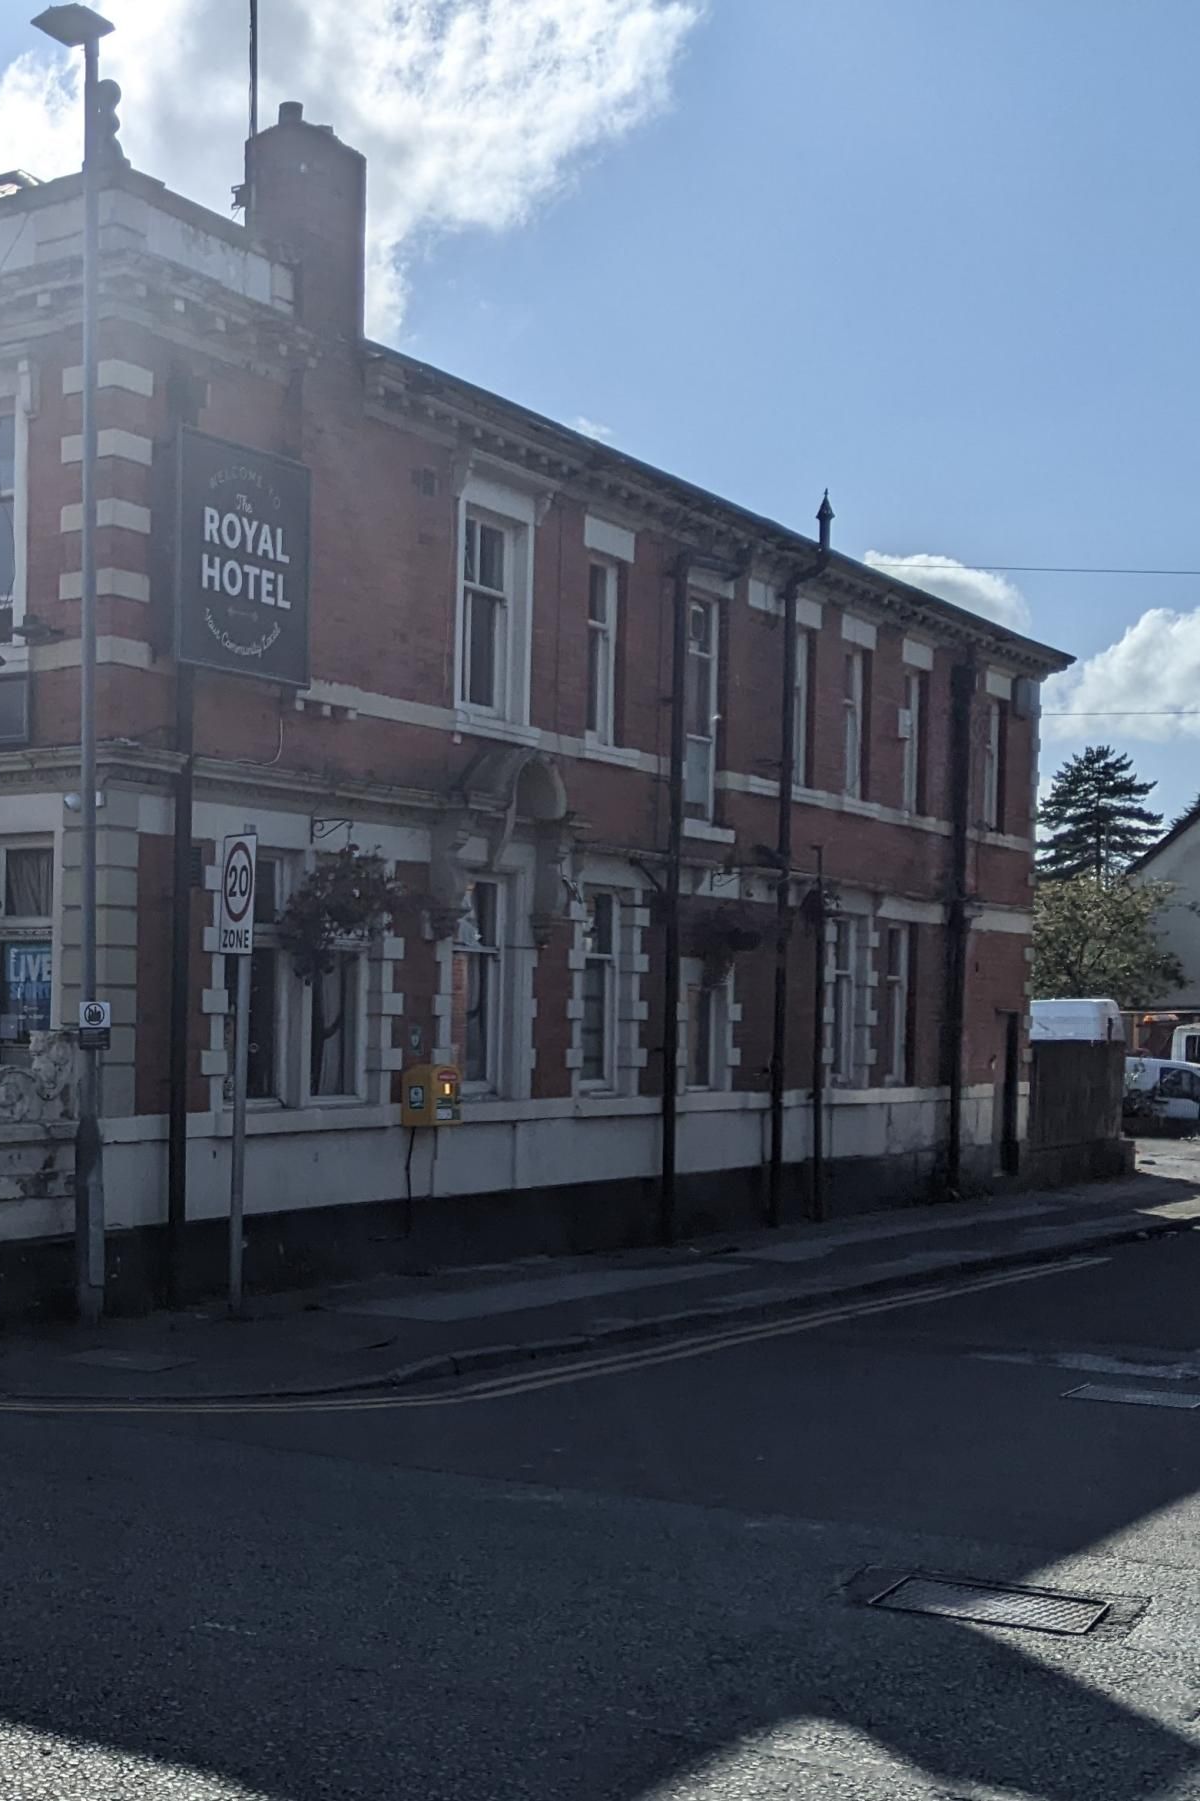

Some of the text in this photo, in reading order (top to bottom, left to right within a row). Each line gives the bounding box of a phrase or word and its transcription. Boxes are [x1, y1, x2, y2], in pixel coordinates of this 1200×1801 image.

[236, 493, 253, 514] The
[204, 506, 290, 564] ROYAL
[201, 553, 291, 610] HOTEL
[228, 865, 249, 897] 20
[222, 929, 249, 949] ZONE
[9, 953, 52, 982] LIVE
